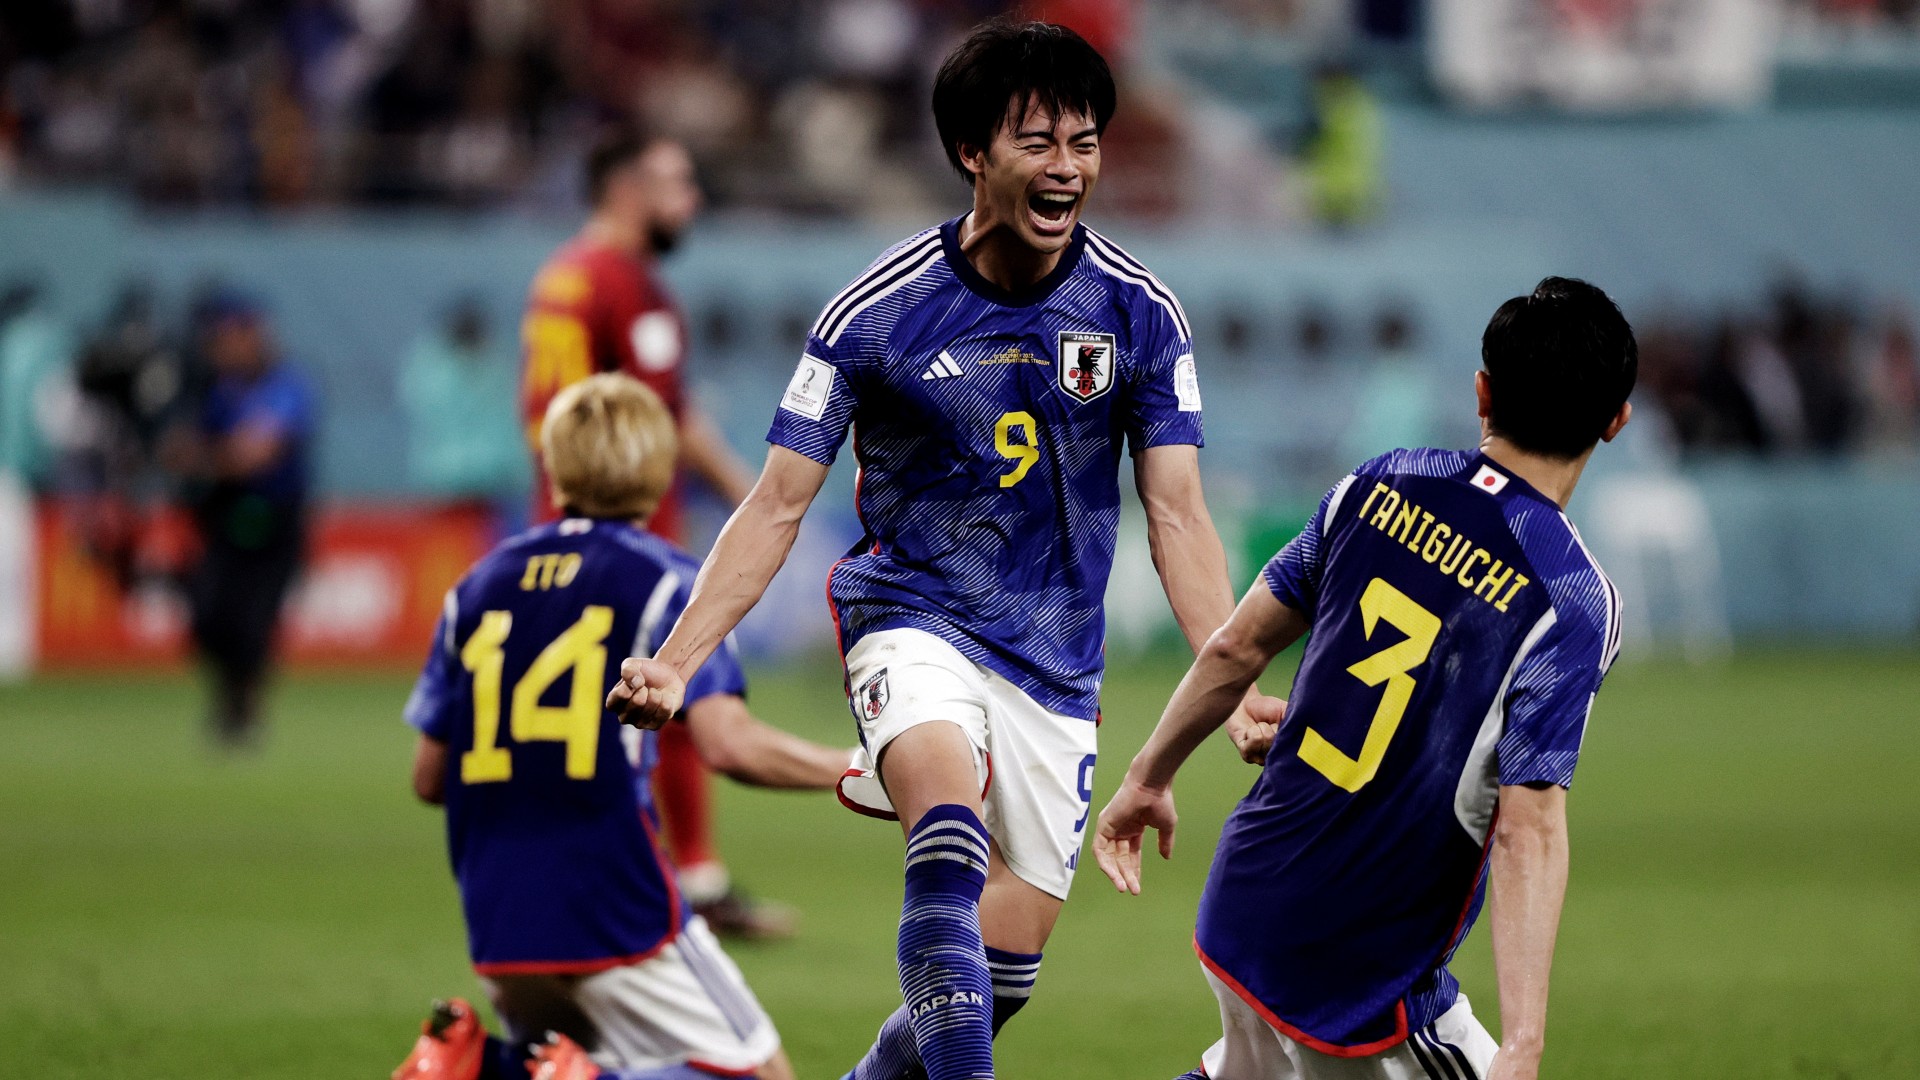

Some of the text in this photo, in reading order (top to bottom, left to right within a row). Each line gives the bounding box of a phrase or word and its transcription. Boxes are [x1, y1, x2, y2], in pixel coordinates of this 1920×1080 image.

[1073, 334, 1102, 342] JAPAN
[1073, 379, 1098, 391] JFA
[994, 410, 1040, 488] 9
[519, 552, 583, 591] ITO
[1357, 481, 1530, 613] TANIGUCHI
[460, 604, 615, 785] 14
[1296, 576, 1442, 794] 3
[1073, 753, 1097, 833] 9
[910, 991, 984, 1021] JAPAN
